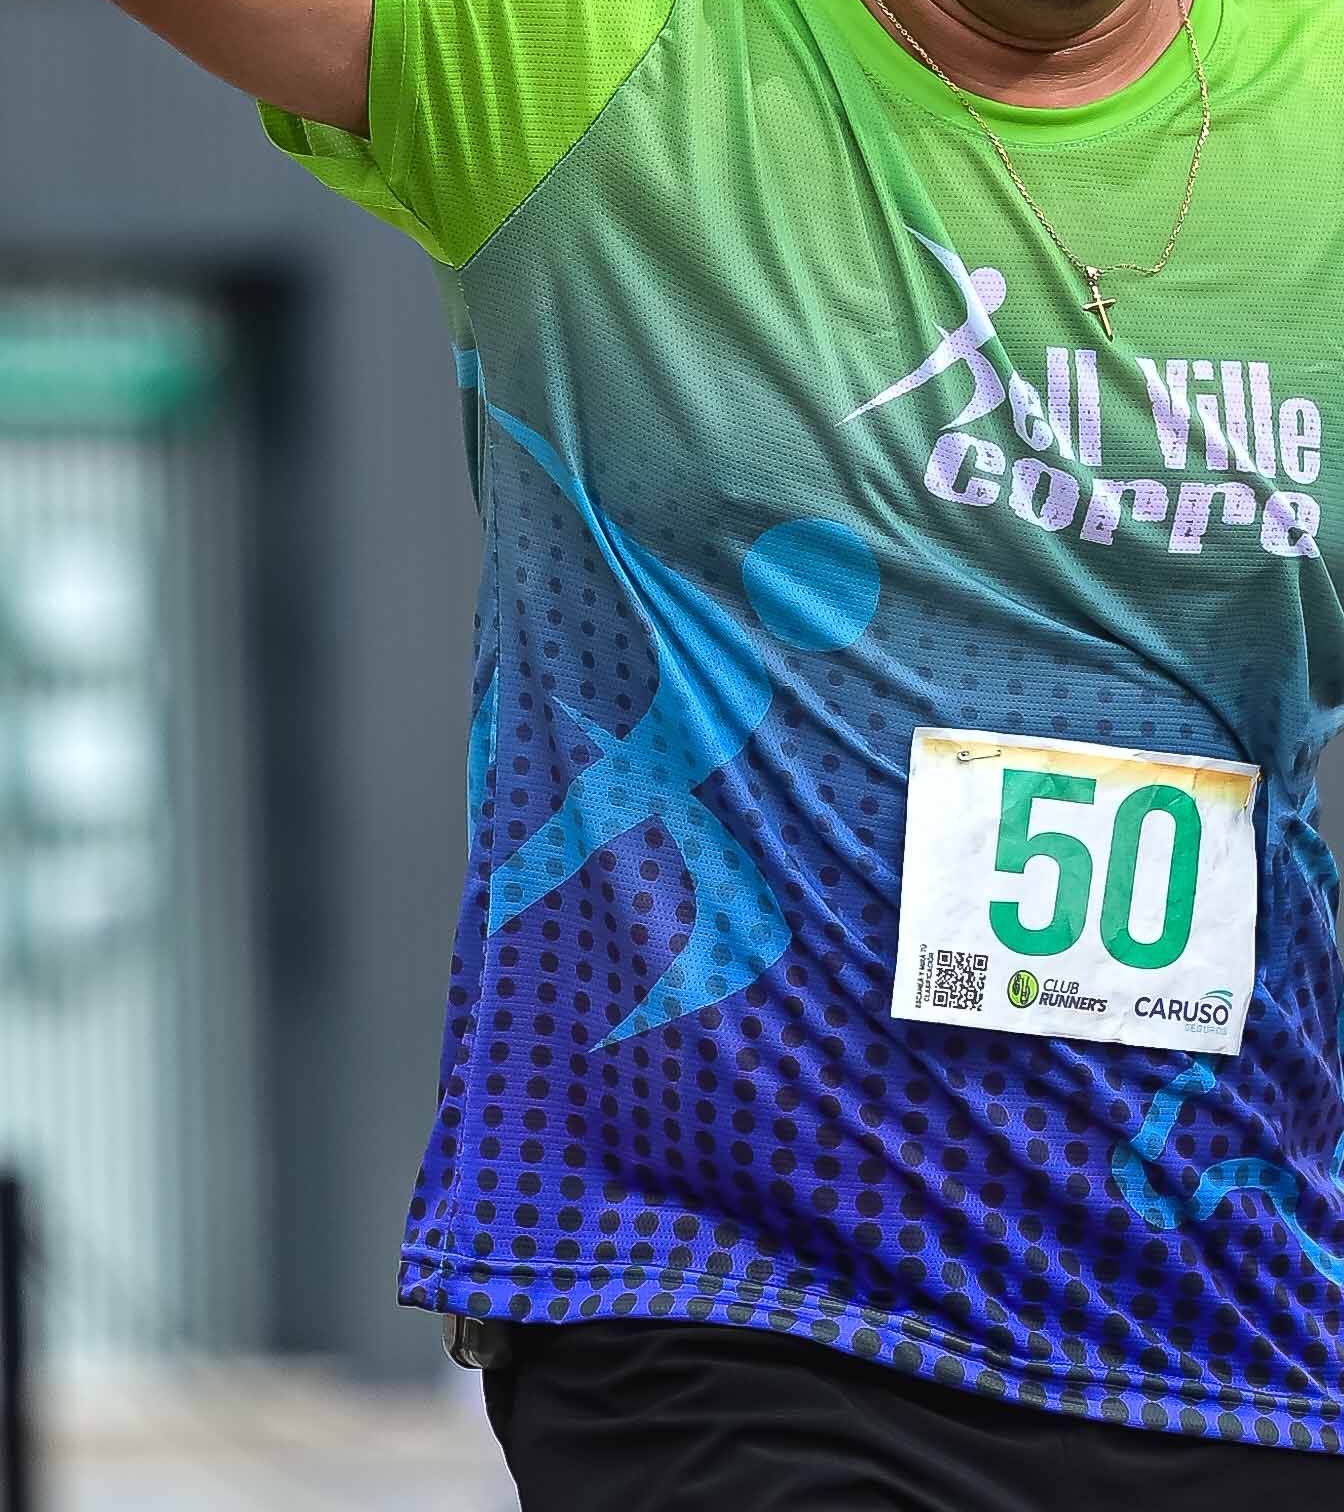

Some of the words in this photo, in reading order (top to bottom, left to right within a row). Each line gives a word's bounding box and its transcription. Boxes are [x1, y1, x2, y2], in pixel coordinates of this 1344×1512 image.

[1135, 357, 1323, 484] Ville
[989, 768, 1202, 970] 50
[1039, 992, 1108, 1012] RUNNER'S
[1043, 979, 1080, 995] CLUB
[1135, 996, 1229, 1026] CARUSO
